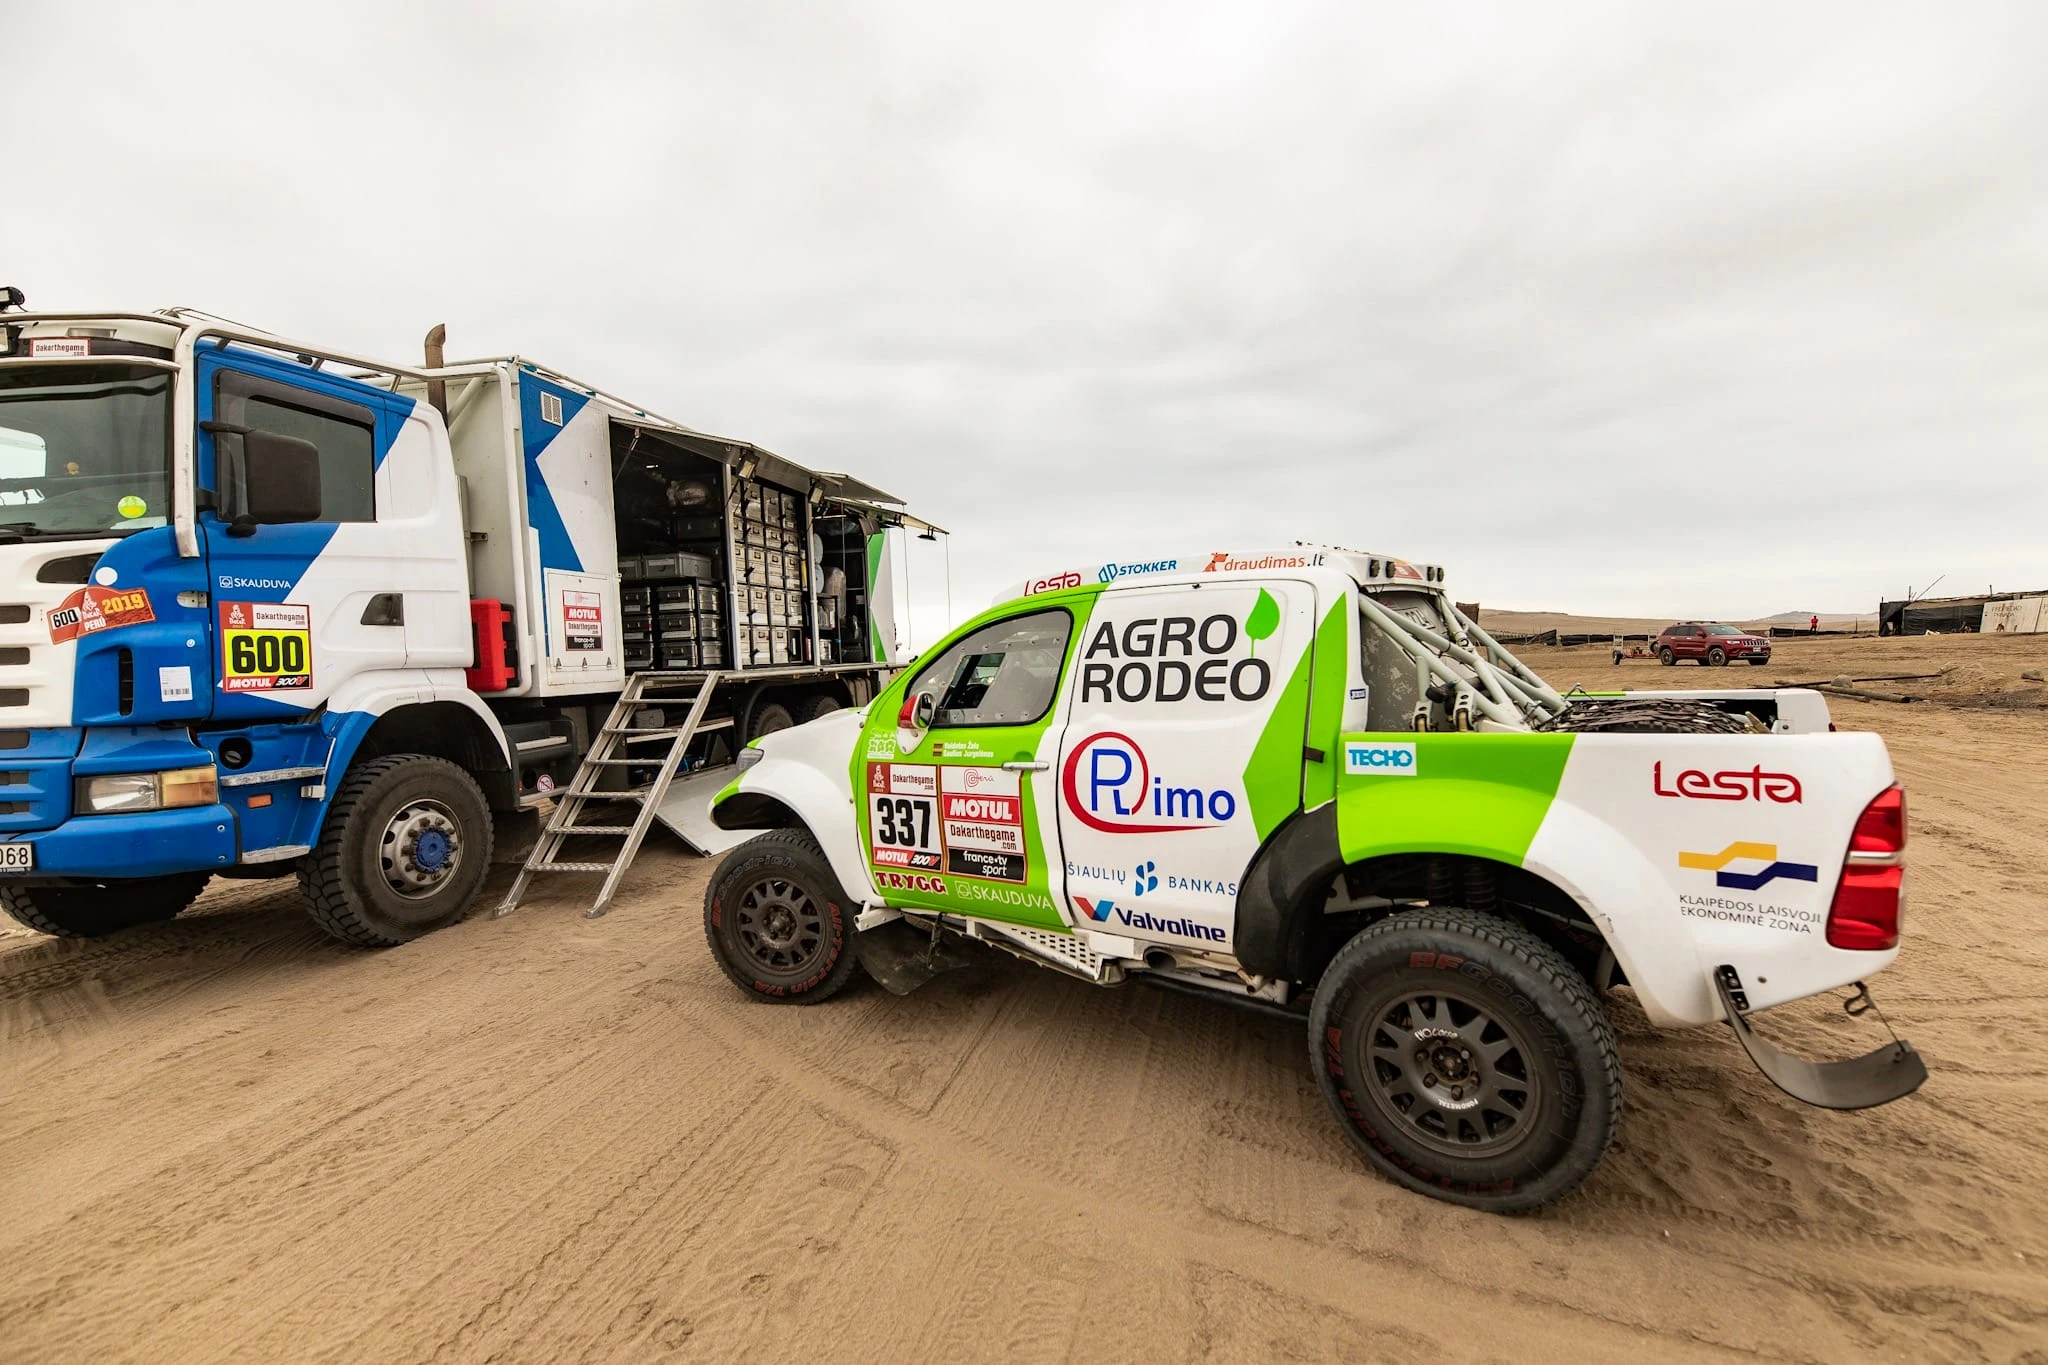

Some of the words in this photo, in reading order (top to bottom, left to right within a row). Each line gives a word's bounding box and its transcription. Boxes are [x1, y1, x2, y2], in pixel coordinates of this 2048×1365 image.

[1118, 559, 1177, 576] STOKKER
[1224, 552, 1325, 571] draudimas.lt
[234, 577, 292, 589] SKAUDUVA
[1024, 571, 1081, 597] Lesta
[102, 593, 145, 615] 2019
[52, 609, 80, 628] 600
[568, 608, 598, 620] MOTUL
[1084, 613, 1238, 660] AGRO
[231, 635, 304, 674] 600
[229, 678, 272, 688] MOTUL
[275, 676, 309, 686] 300V
[1081, 657, 1271, 703] RODEO
[1348, 748, 1413, 768] TECHO
[892, 774, 934, 785] Dakarthegame
[1653, 760, 1803, 804] Lesta
[949, 798, 1013, 820] MOTUL
[876, 797, 931, 849] 337
[950, 824, 1016, 842] Dakarthegame
[1000, 841, 1017, 851] .com
[876, 850, 909, 864] MOTUL
[910, 854, 941, 867] 300V
[982, 864, 1007, 877] sport
[1067, 861, 1127, 885] ŠIAULIŲ
[1168, 876, 1237, 896] BANKAS
[874, 871, 947, 894] TRYGG
[972, 885, 1054, 911] SKAUDUVA
[1679, 894, 1755, 912] KLAIPĖDOS
[1115, 907, 1227, 943] Valvoline
[1680, 906, 1765, 926] EKONOMINĖ
[1768, 918, 1812, 934] ZONA
